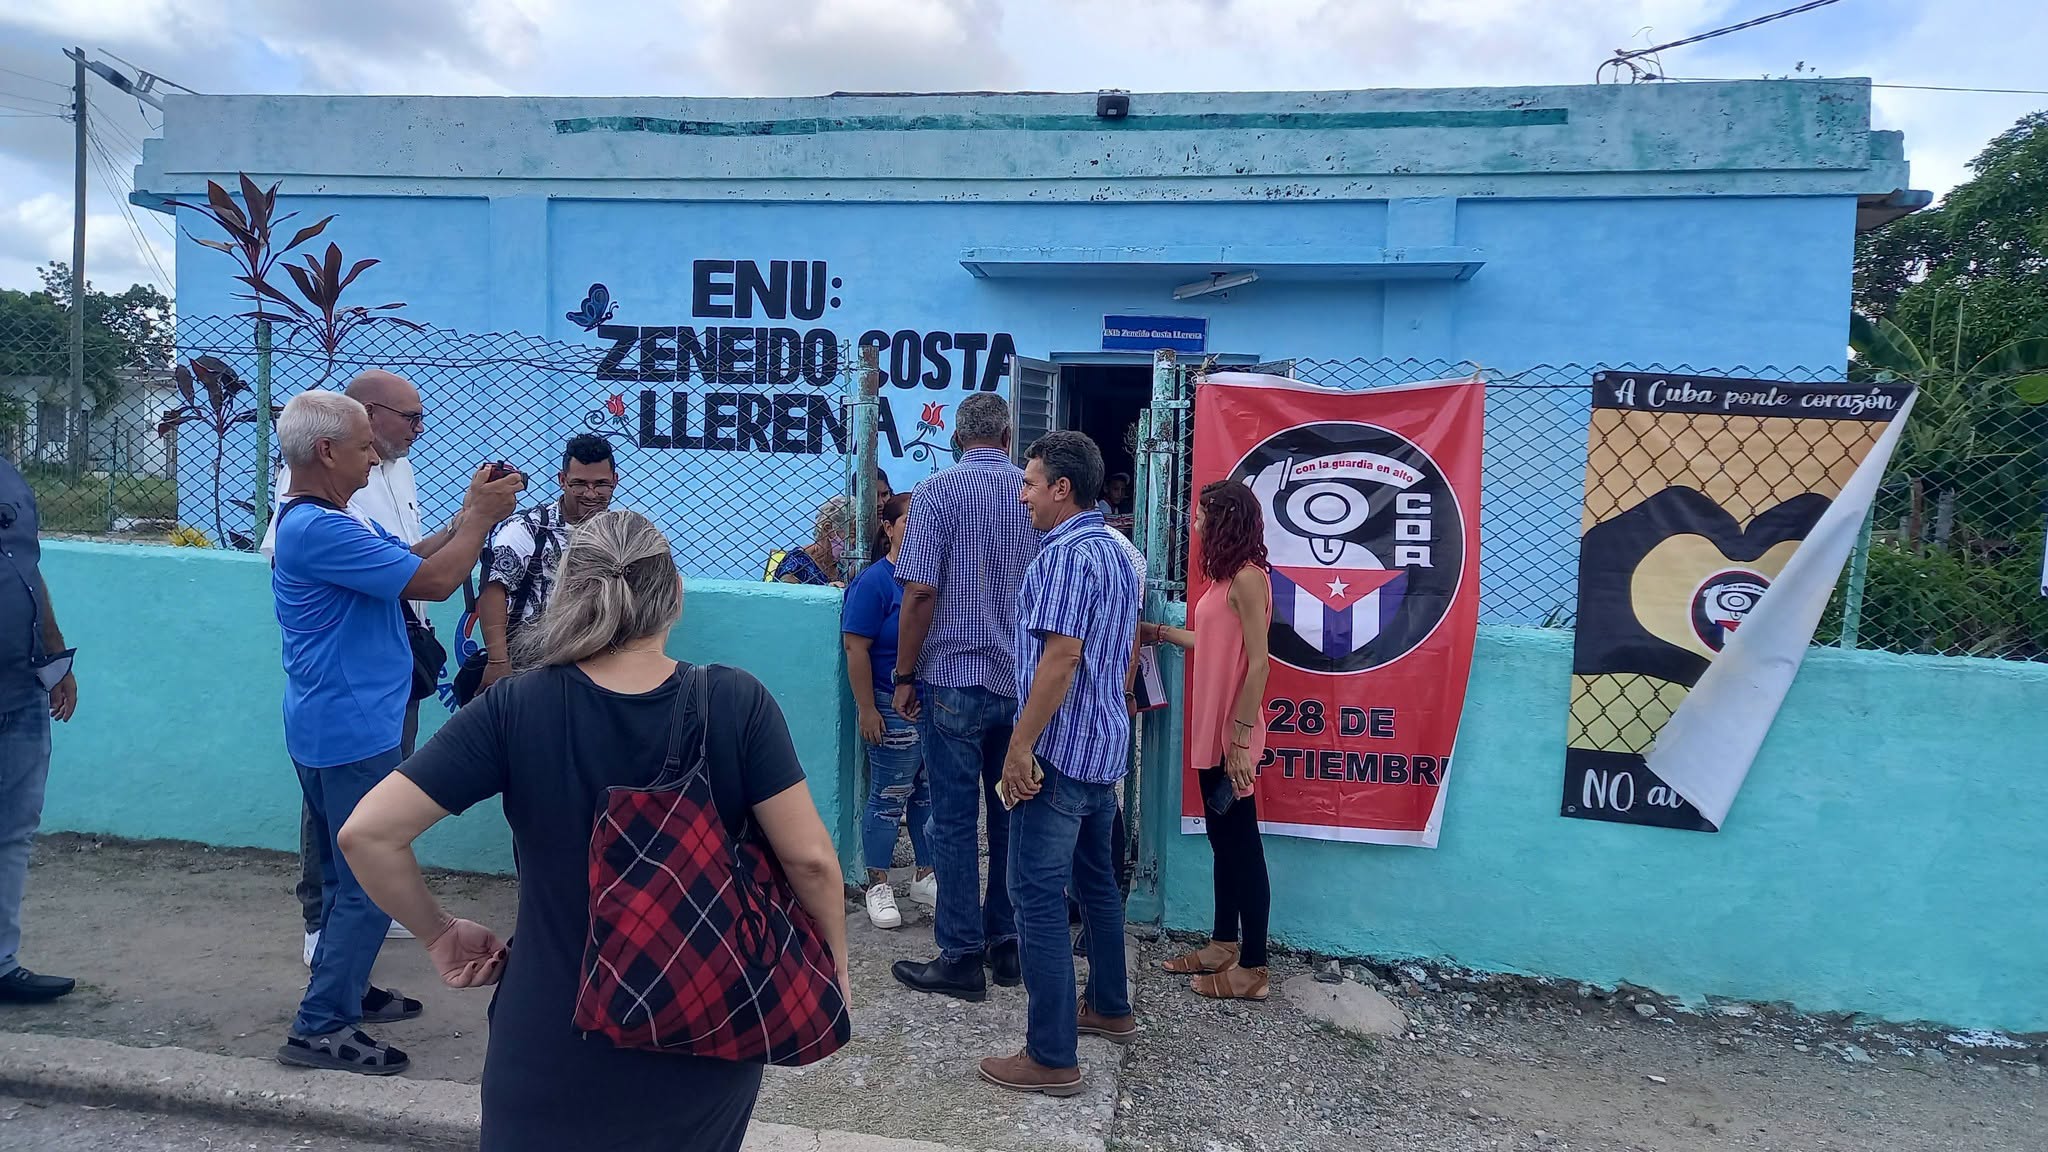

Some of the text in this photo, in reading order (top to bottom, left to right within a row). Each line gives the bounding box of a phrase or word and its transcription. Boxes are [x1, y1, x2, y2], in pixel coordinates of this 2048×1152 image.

[692, 260, 842, 320] ENU:
[596, 325, 1016, 391] ZENEIDO COSTA
[1614, 378, 1898, 416] A Cuba ponle corazón
[639, 390, 904, 458] LLERENA
[1295, 459, 1413, 483] con la guardia en alto
[1267, 698, 1396, 738] 28 DE
[1255, 747, 1450, 787] PTIEMBR
[1582, 768, 1635, 814] NO
